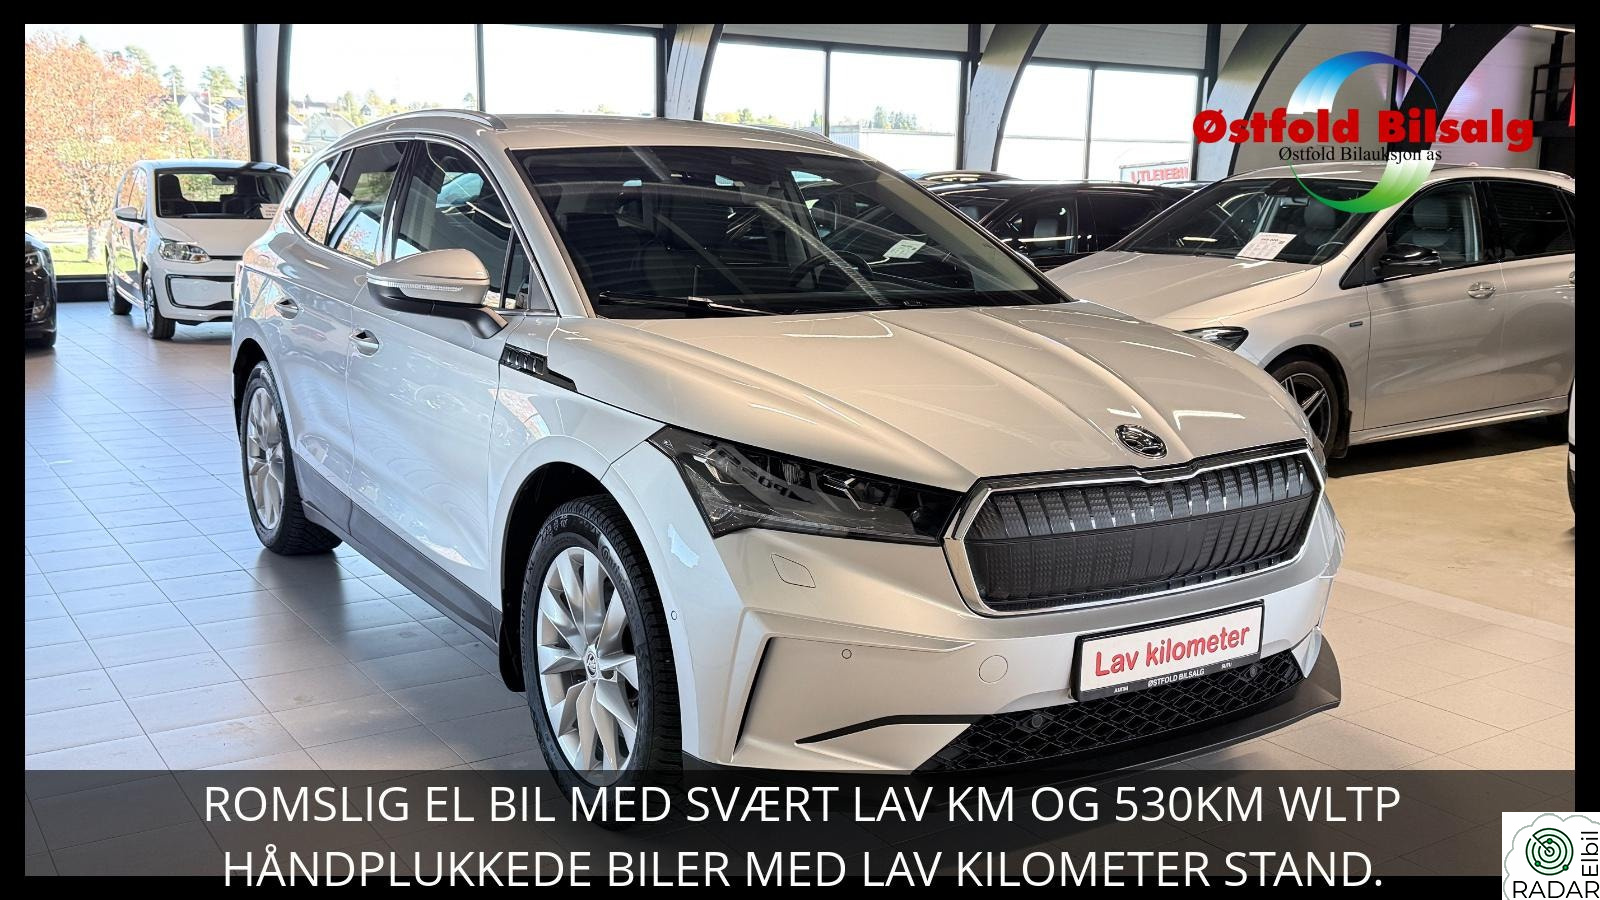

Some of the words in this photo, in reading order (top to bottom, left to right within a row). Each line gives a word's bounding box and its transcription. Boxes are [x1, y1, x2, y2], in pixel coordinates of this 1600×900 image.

[1094, 650, 1140, 677] Lav
[1145, 626, 1250, 667] kilometer
[1147, 673, 1178, 688] ØSTFOLD
[1178, 668, 1205, 682] BILSALG
